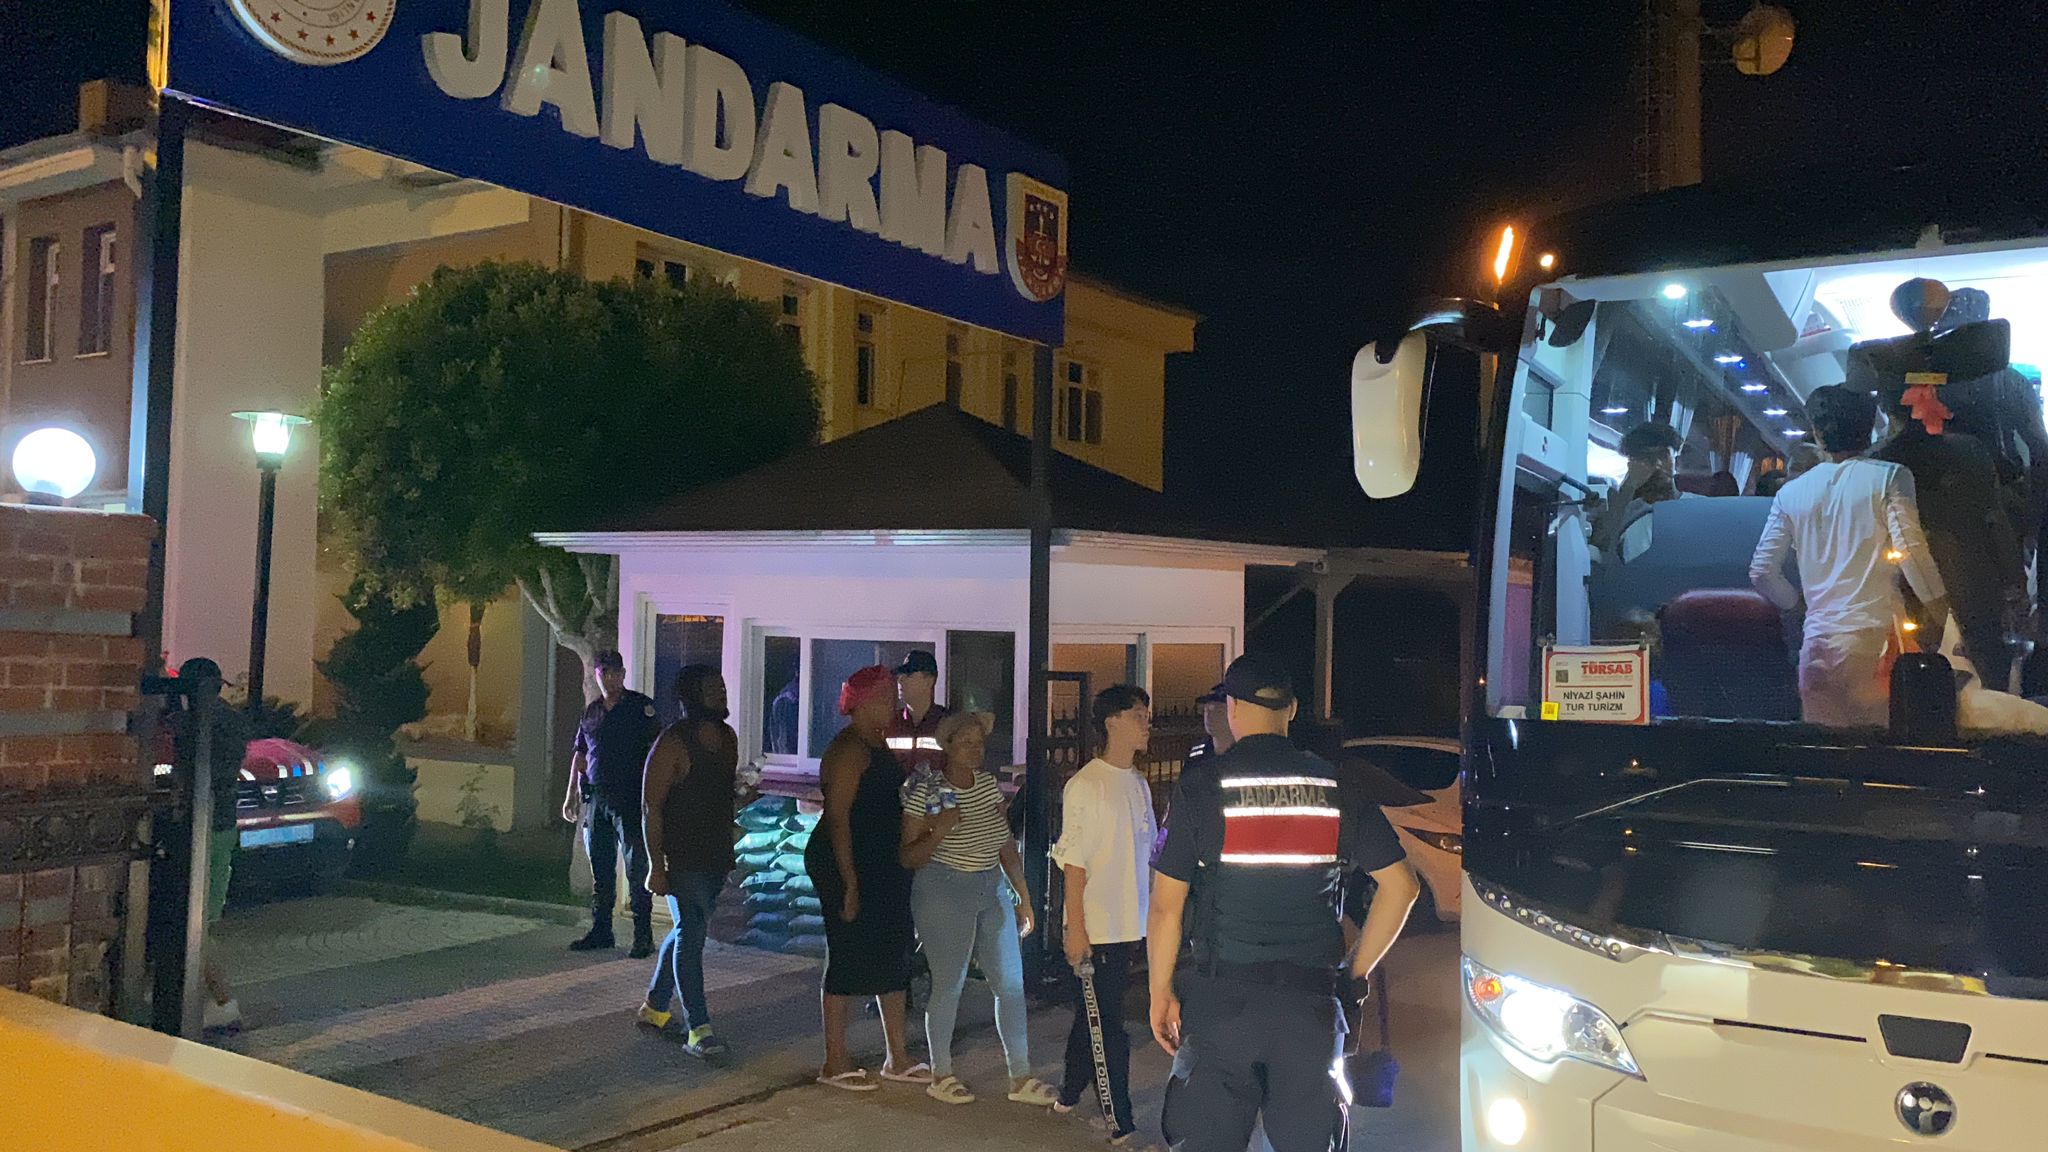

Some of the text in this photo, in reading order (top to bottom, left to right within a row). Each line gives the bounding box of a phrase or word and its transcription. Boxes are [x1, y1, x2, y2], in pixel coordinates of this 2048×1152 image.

[421, 0, 999, 274] JANDARMA
[1581, 662, 1633, 675] TÜRSAB
[1563, 690, 1593, 700] NİYAZİ
[1566, 702, 1623, 711] TUR TURİZM
[1236, 785, 1328, 807] JANDARMA
[1083, 978, 1098, 1018] HUGO
[1090, 1025, 1104, 1063] BOSS
[1098, 1066, 1112, 1106] HUGO
